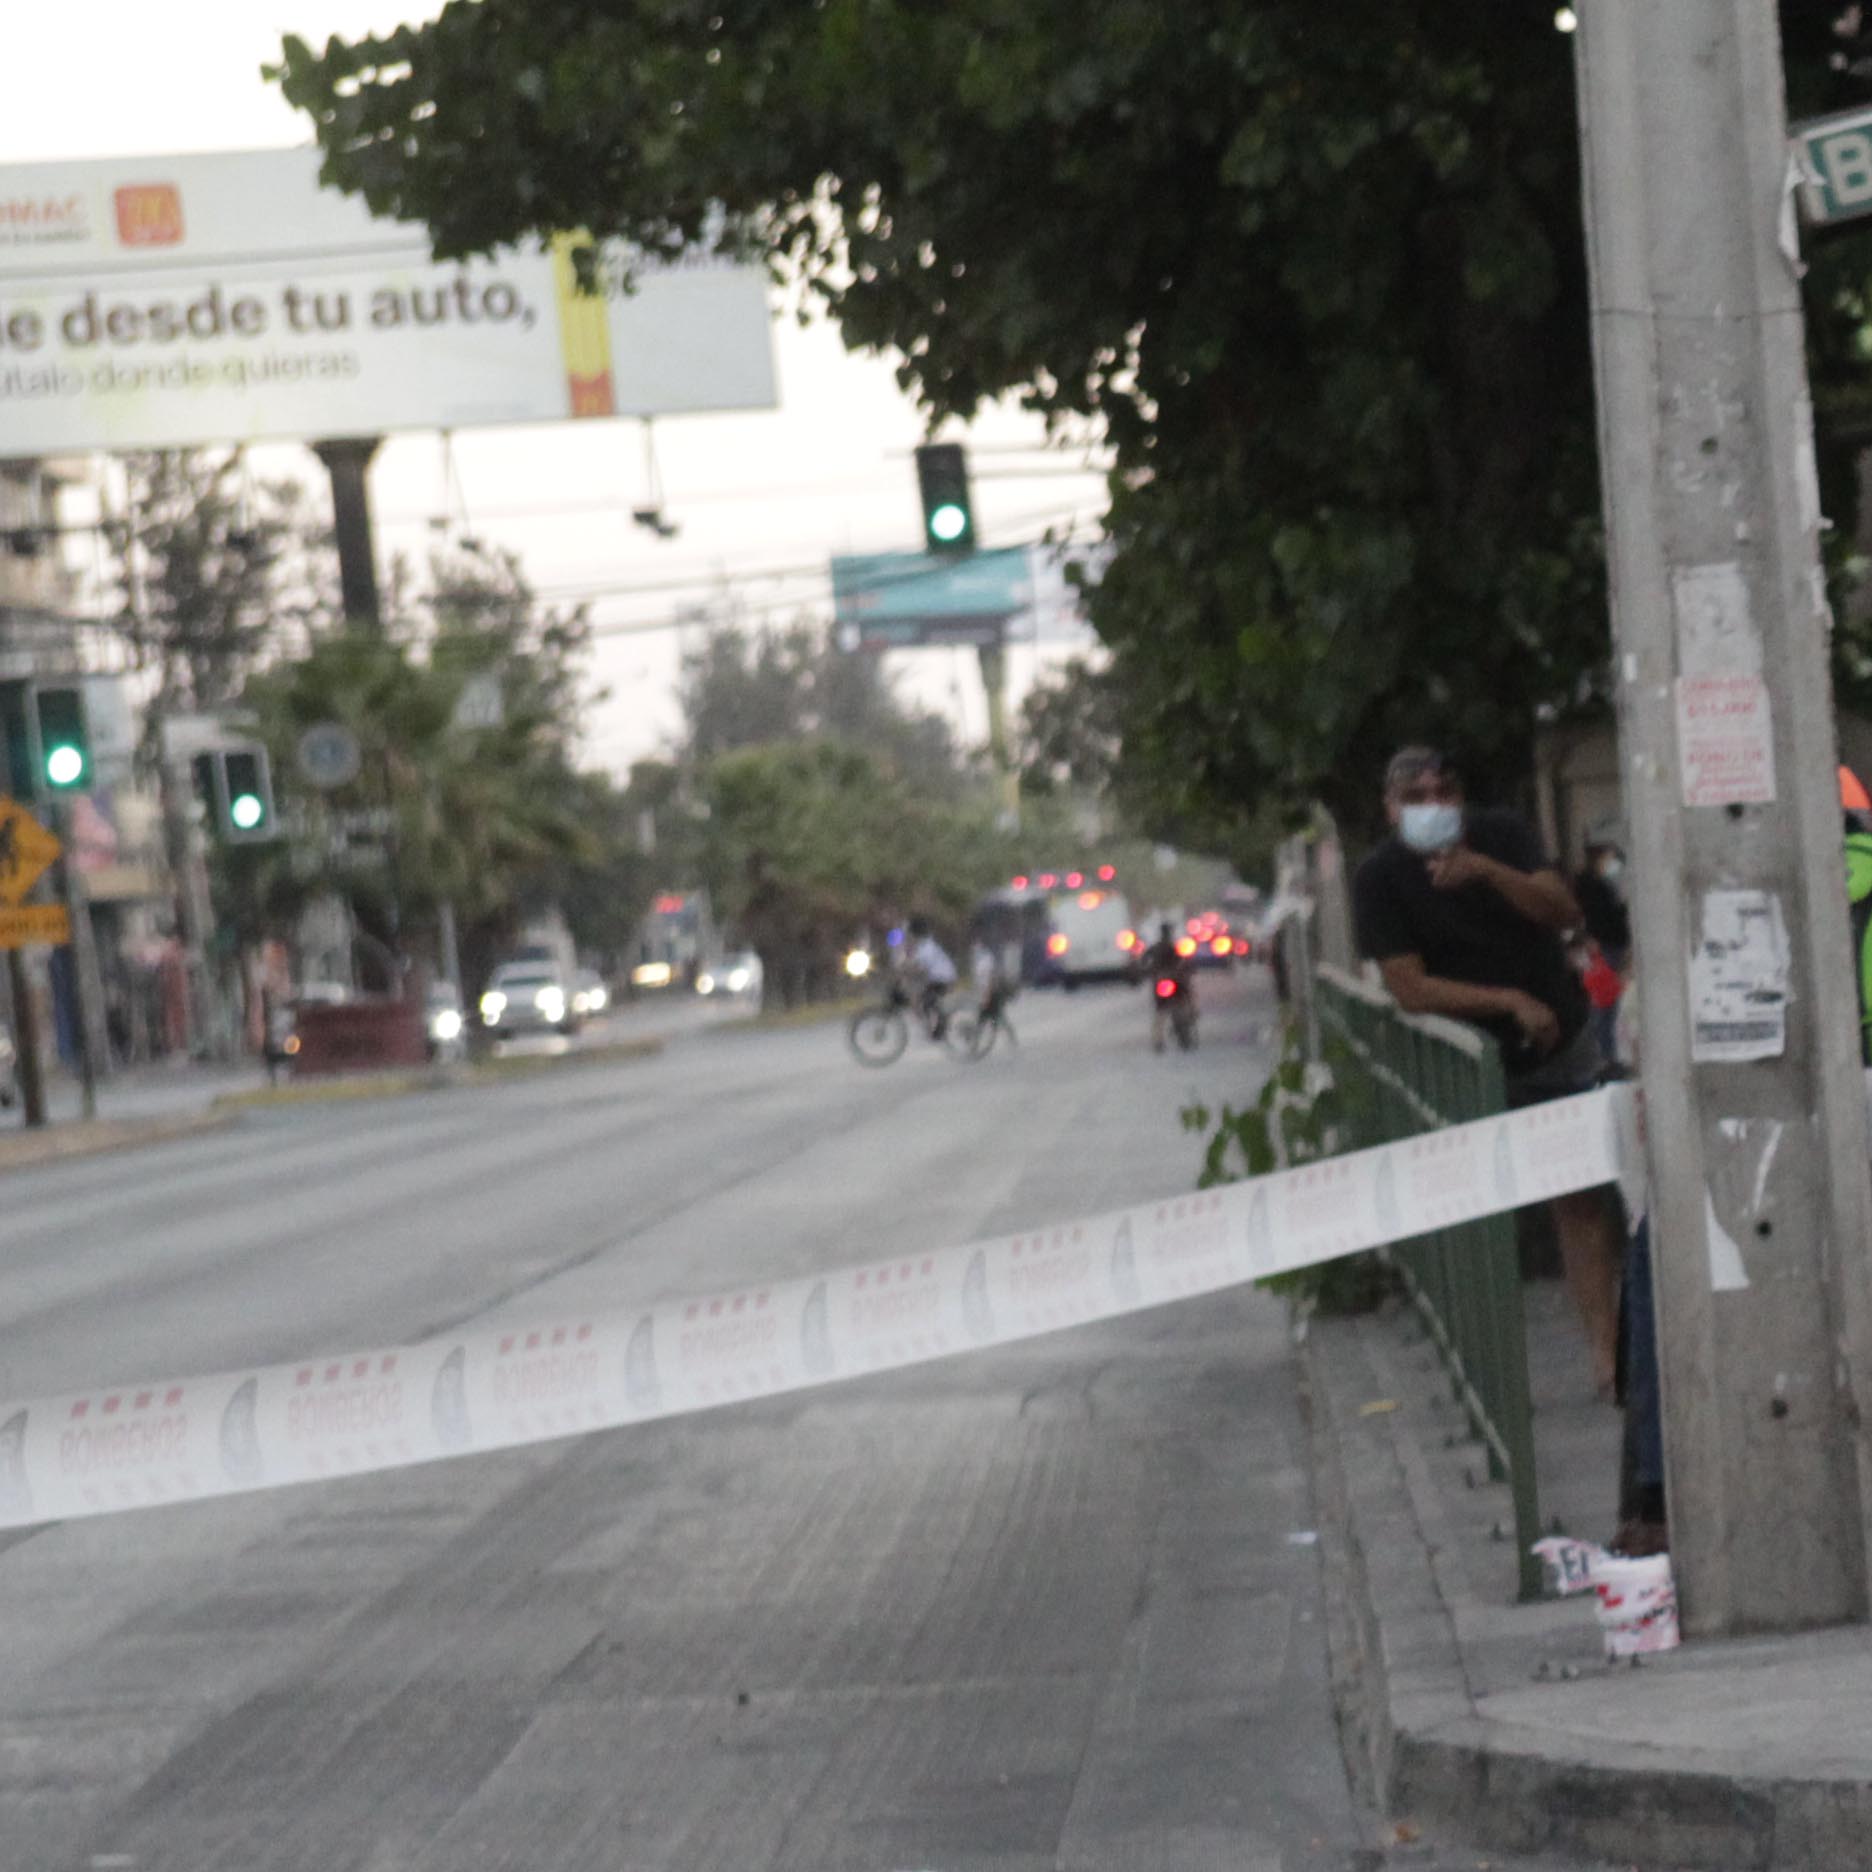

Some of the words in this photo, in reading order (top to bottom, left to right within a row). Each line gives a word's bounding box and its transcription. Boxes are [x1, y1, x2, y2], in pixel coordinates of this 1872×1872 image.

[60, 281, 268, 348] desde
[282, 281, 351, 331] tu
[368, 270, 537, 332] auto,
